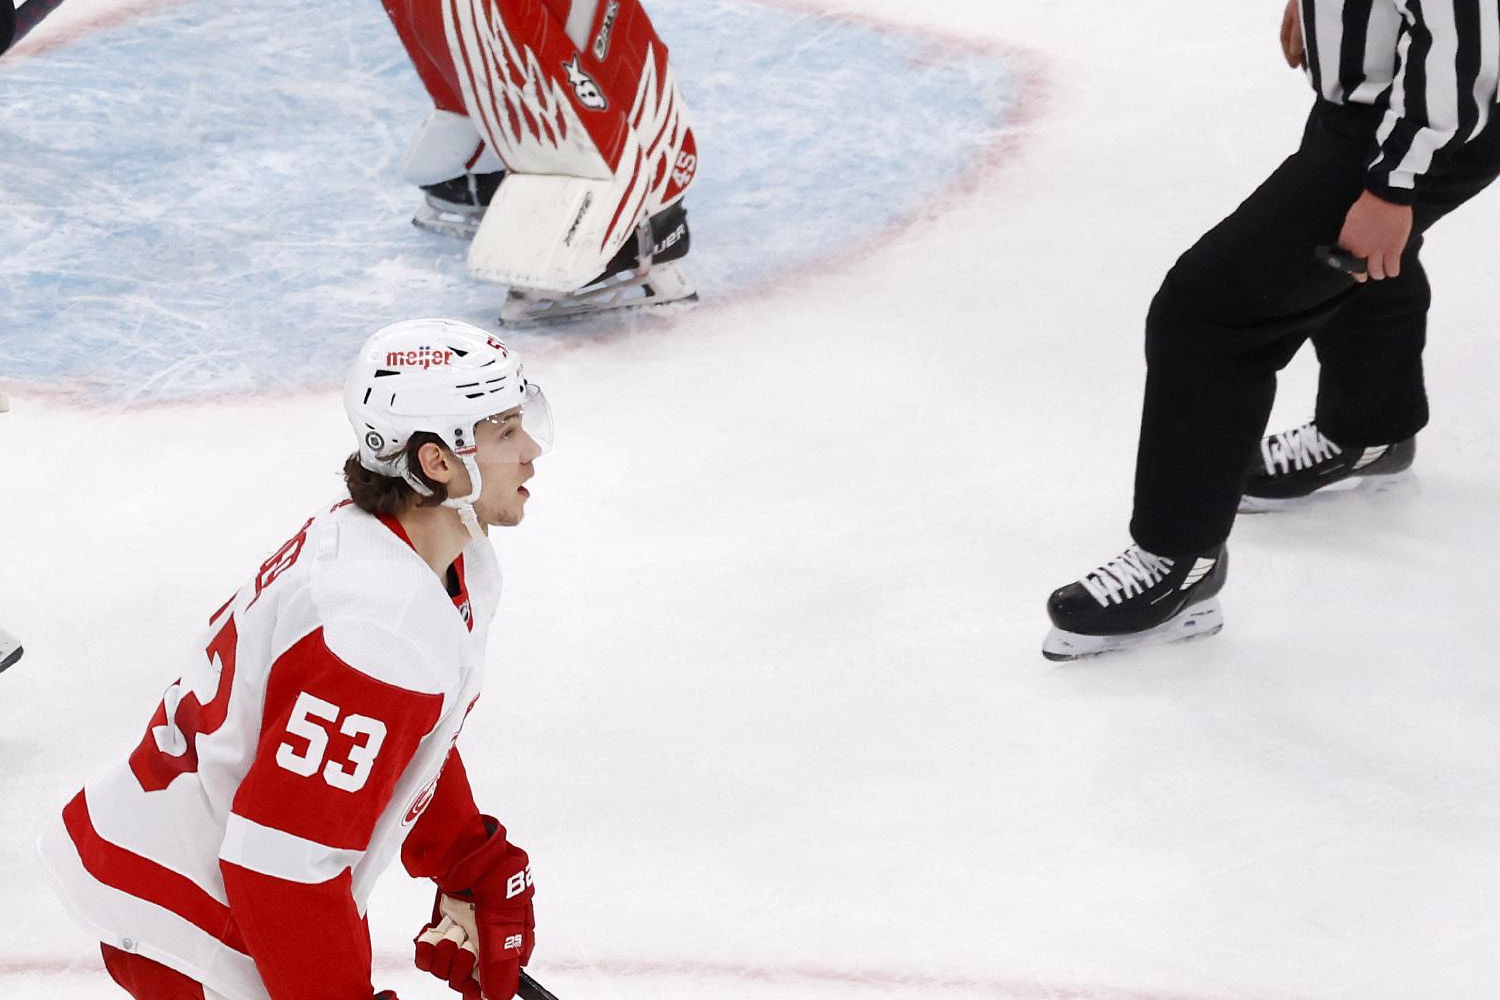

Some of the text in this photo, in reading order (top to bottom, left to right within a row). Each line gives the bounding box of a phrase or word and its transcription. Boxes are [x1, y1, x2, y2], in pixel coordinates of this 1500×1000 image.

[672, 151, 697, 188] 45
[386, 346, 452, 369] meijer
[276, 691, 387, 793] 53
